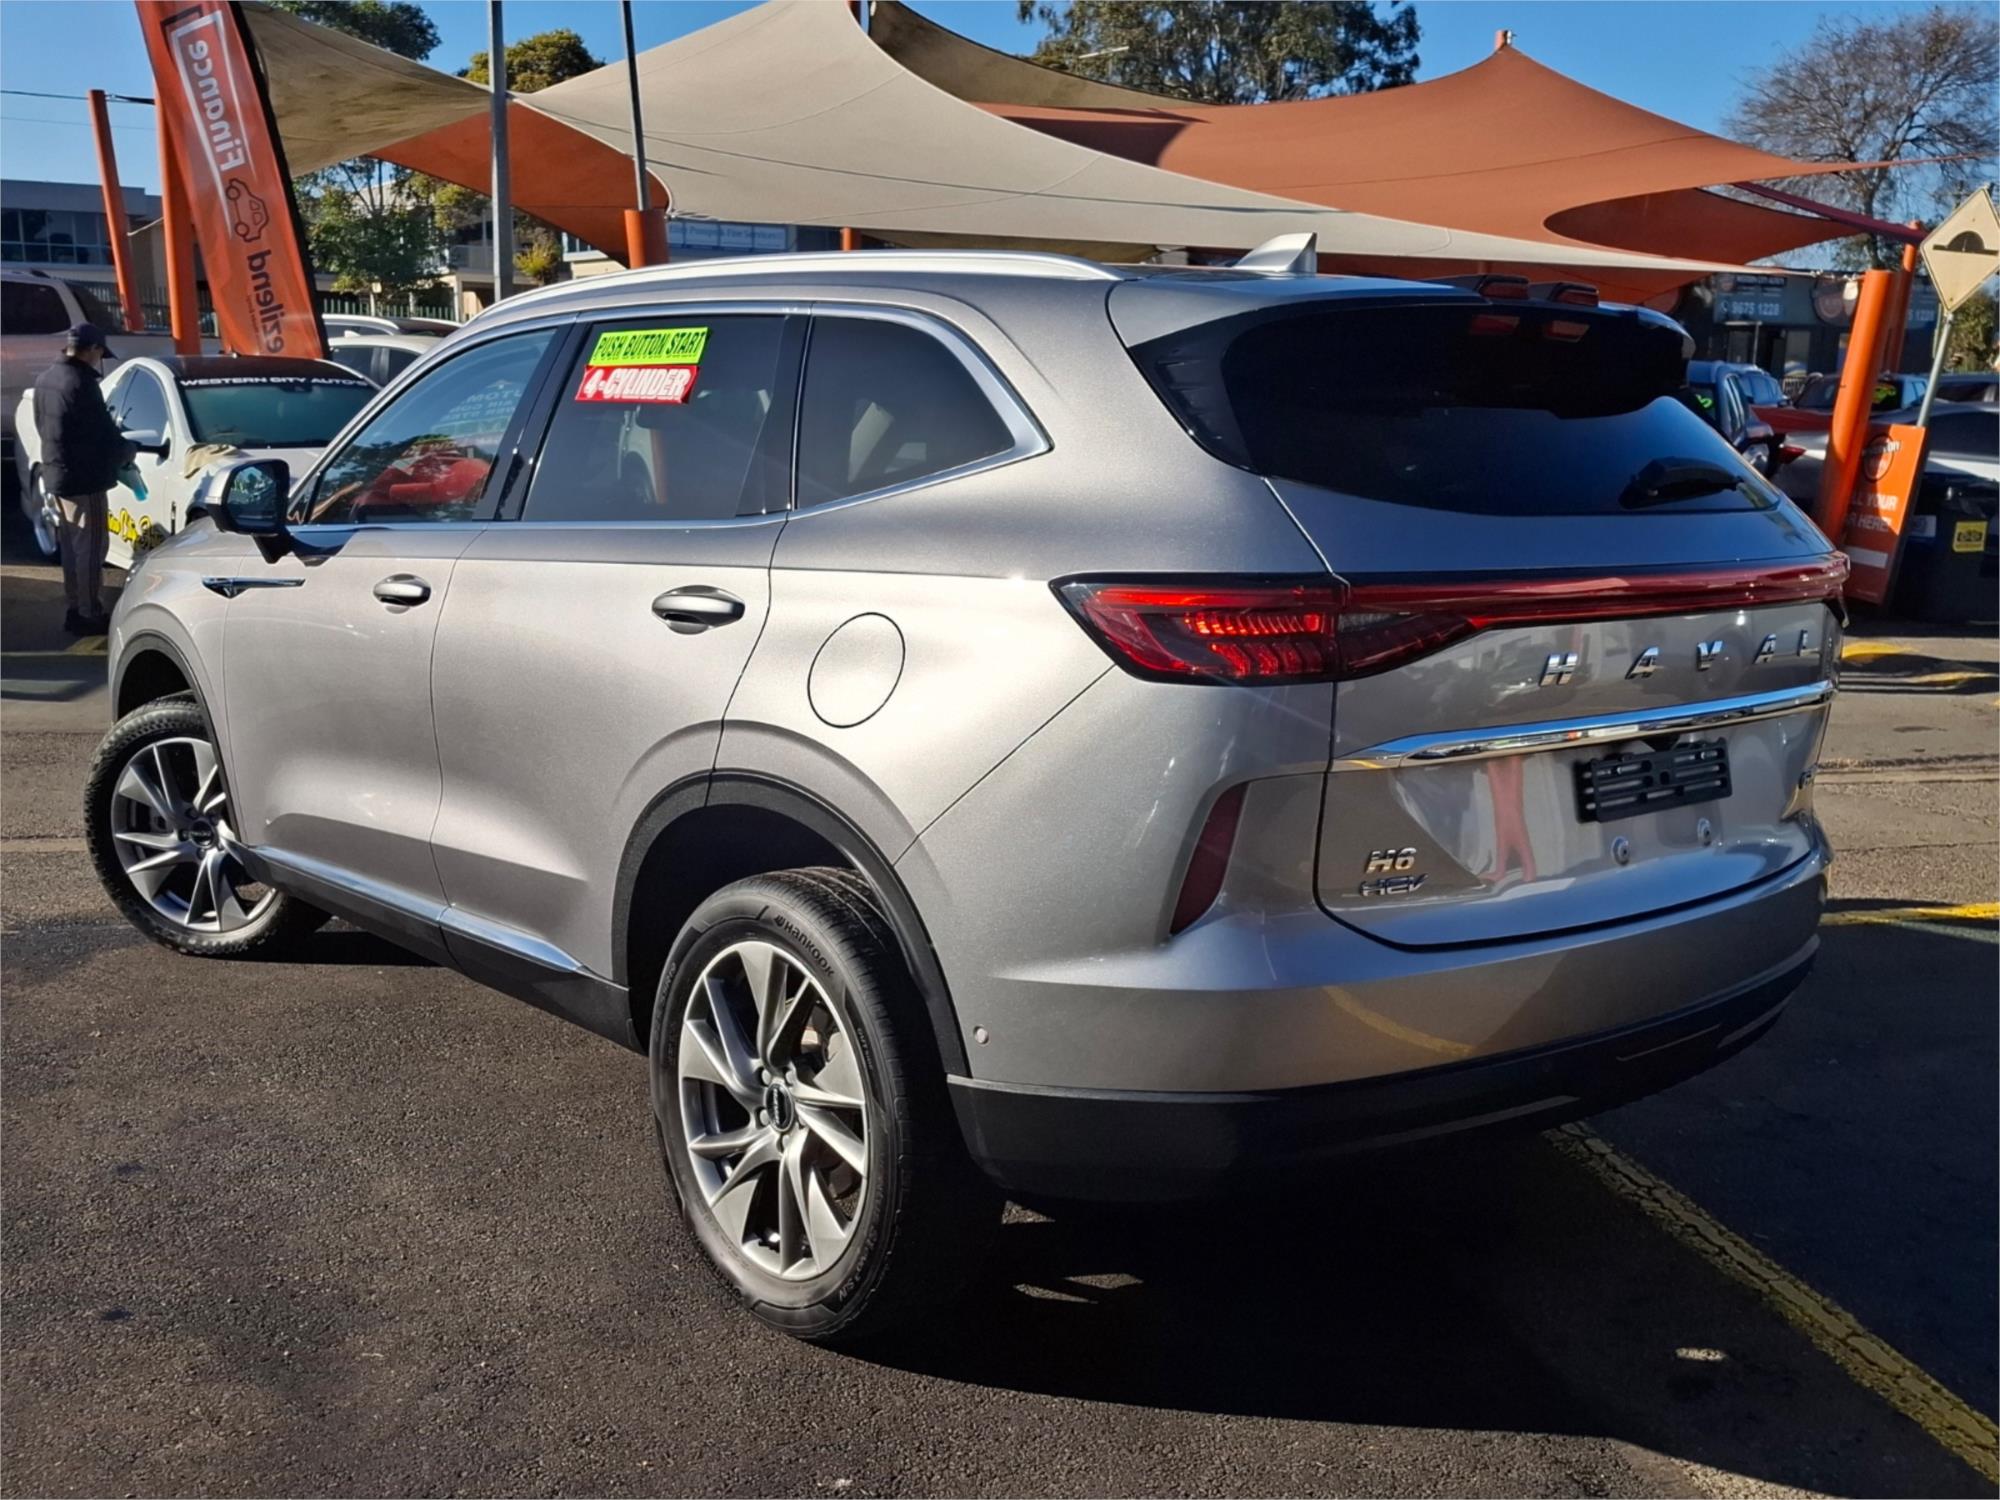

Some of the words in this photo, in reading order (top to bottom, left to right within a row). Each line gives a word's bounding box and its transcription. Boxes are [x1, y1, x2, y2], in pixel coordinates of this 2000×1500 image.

[593, 334, 628, 360] PUSH
[622, 333, 671, 359] BUTTON
[665, 331, 706, 358] START
[180, 376, 268, 387] WESTERN
[270, 376, 307, 385] CITY
[311, 377, 369, 387] AUTO'S
[583, 368, 692, 400] 4-CYLINDER
[1866, 493, 1898, 511] YOUR
[1540, 629, 1818, 687] HAVAL
[1364, 847, 1417, 875] H6
[1360, 873, 1429, 897] HEV
